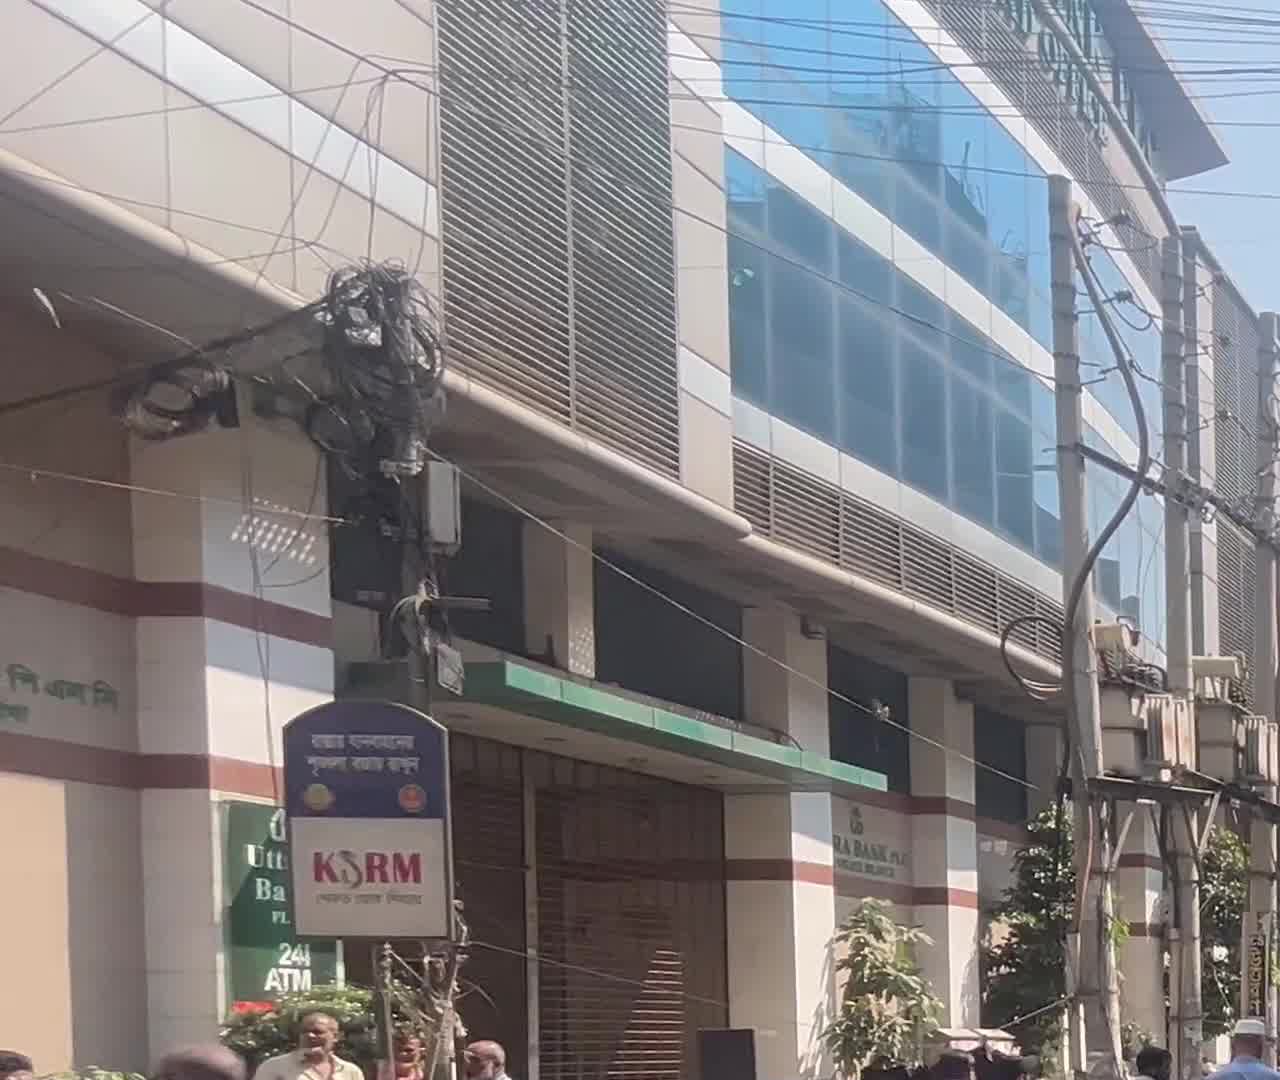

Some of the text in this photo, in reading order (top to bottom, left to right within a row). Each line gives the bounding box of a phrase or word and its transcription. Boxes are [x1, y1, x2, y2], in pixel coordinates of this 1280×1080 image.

[245, 844, 289, 870] Utt
[313, 850, 422, 889] KSRM
[255, 878, 287, 901] Ba
[271, 911, 291, 924] PL
[264, 967, 312, 992] ATM
